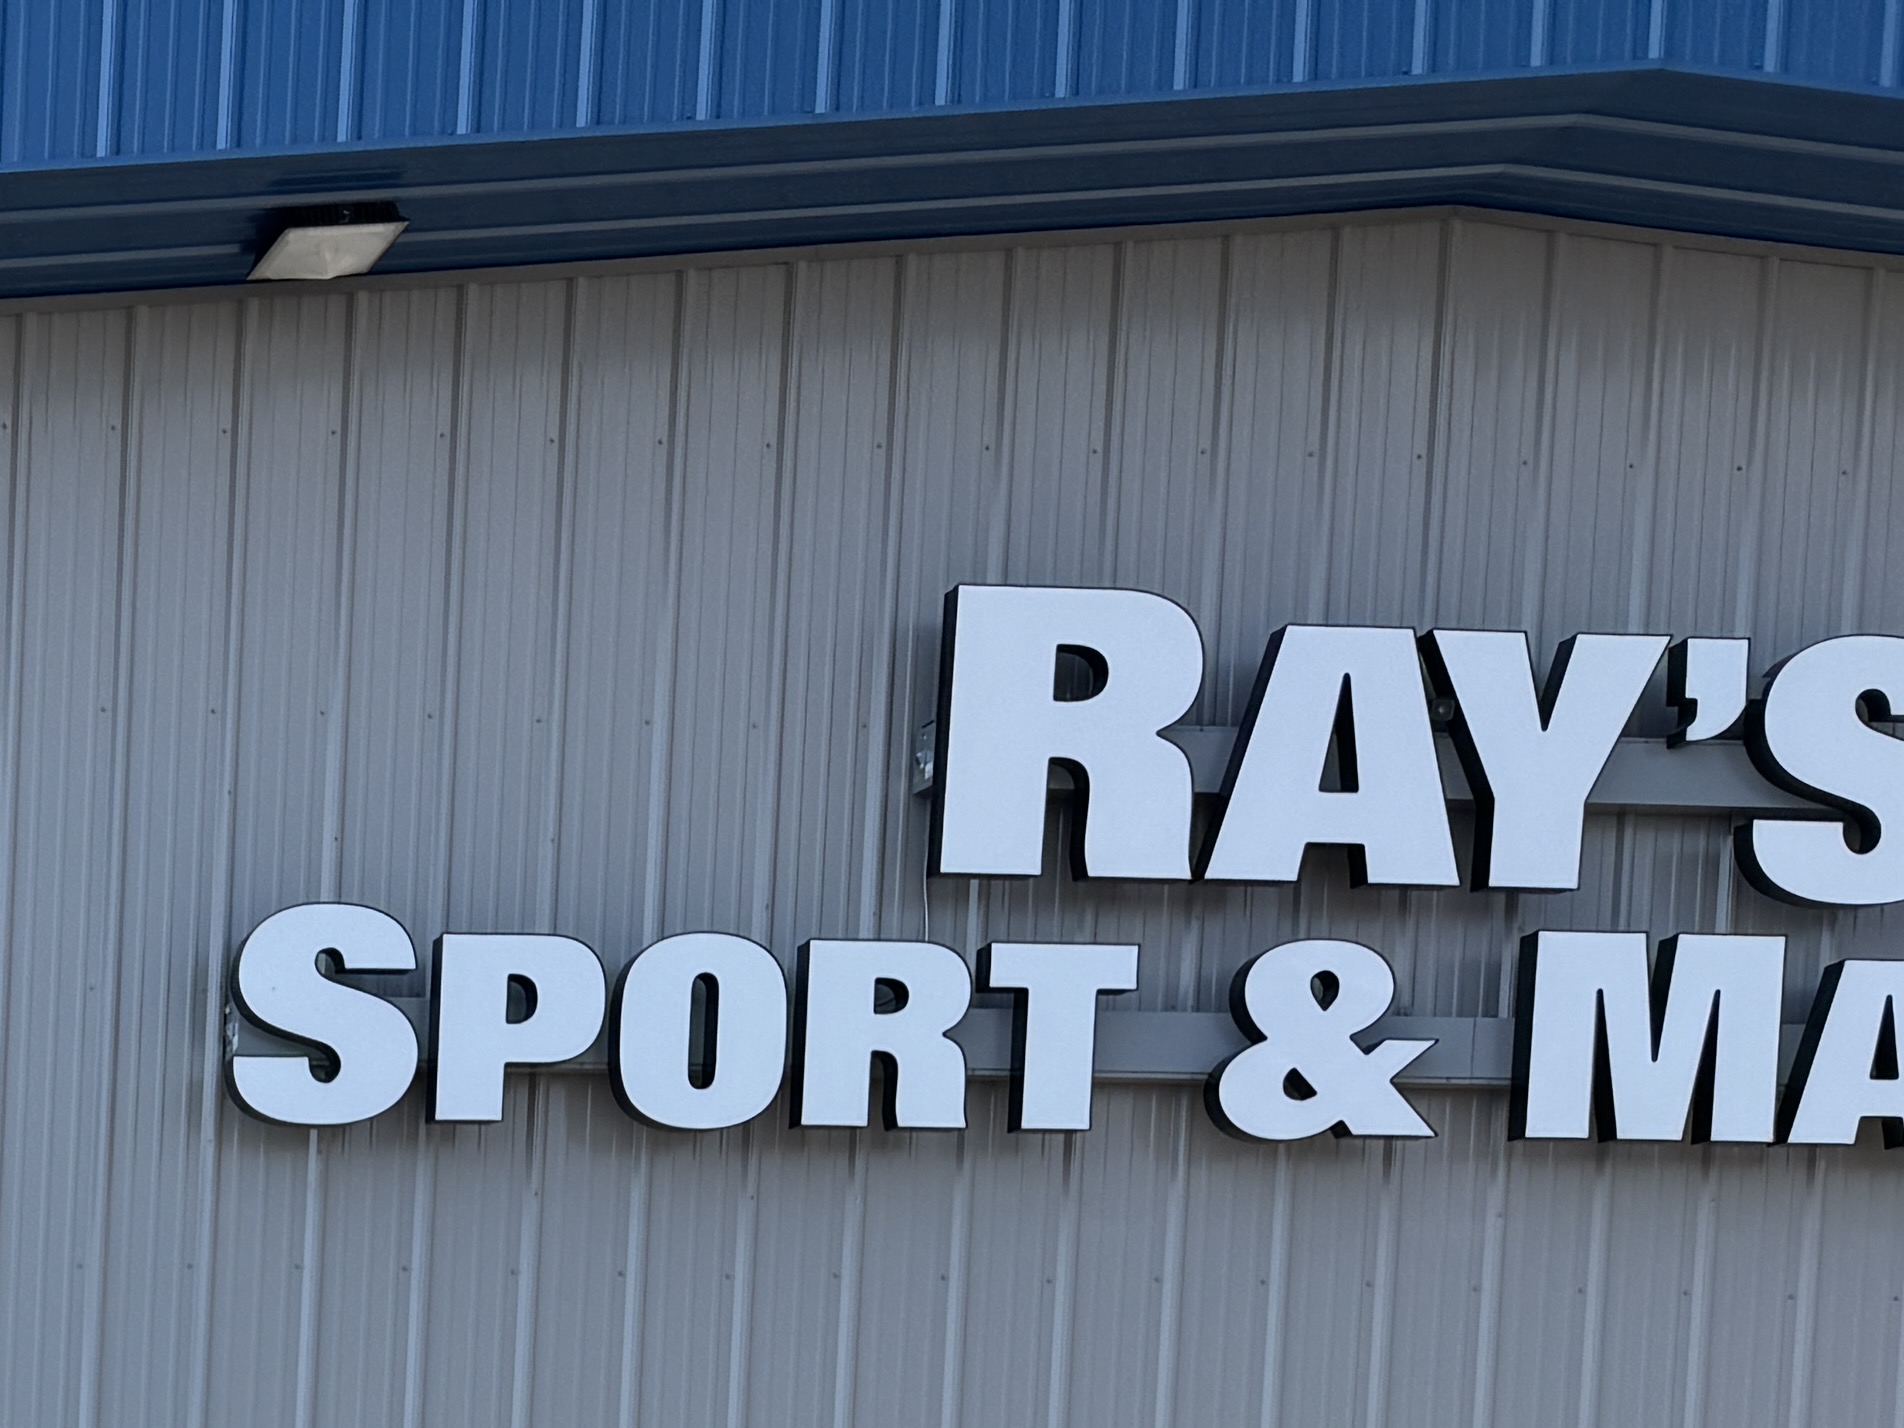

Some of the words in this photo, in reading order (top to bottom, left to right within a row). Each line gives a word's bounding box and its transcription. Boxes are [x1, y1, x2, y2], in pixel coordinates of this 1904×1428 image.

[937, 582, 1904, 907] RAY'S
[229, 900, 1141, 1130] SPORT
[1210, 937, 1441, 1141] &
[1514, 928, 1904, 1145] MA
